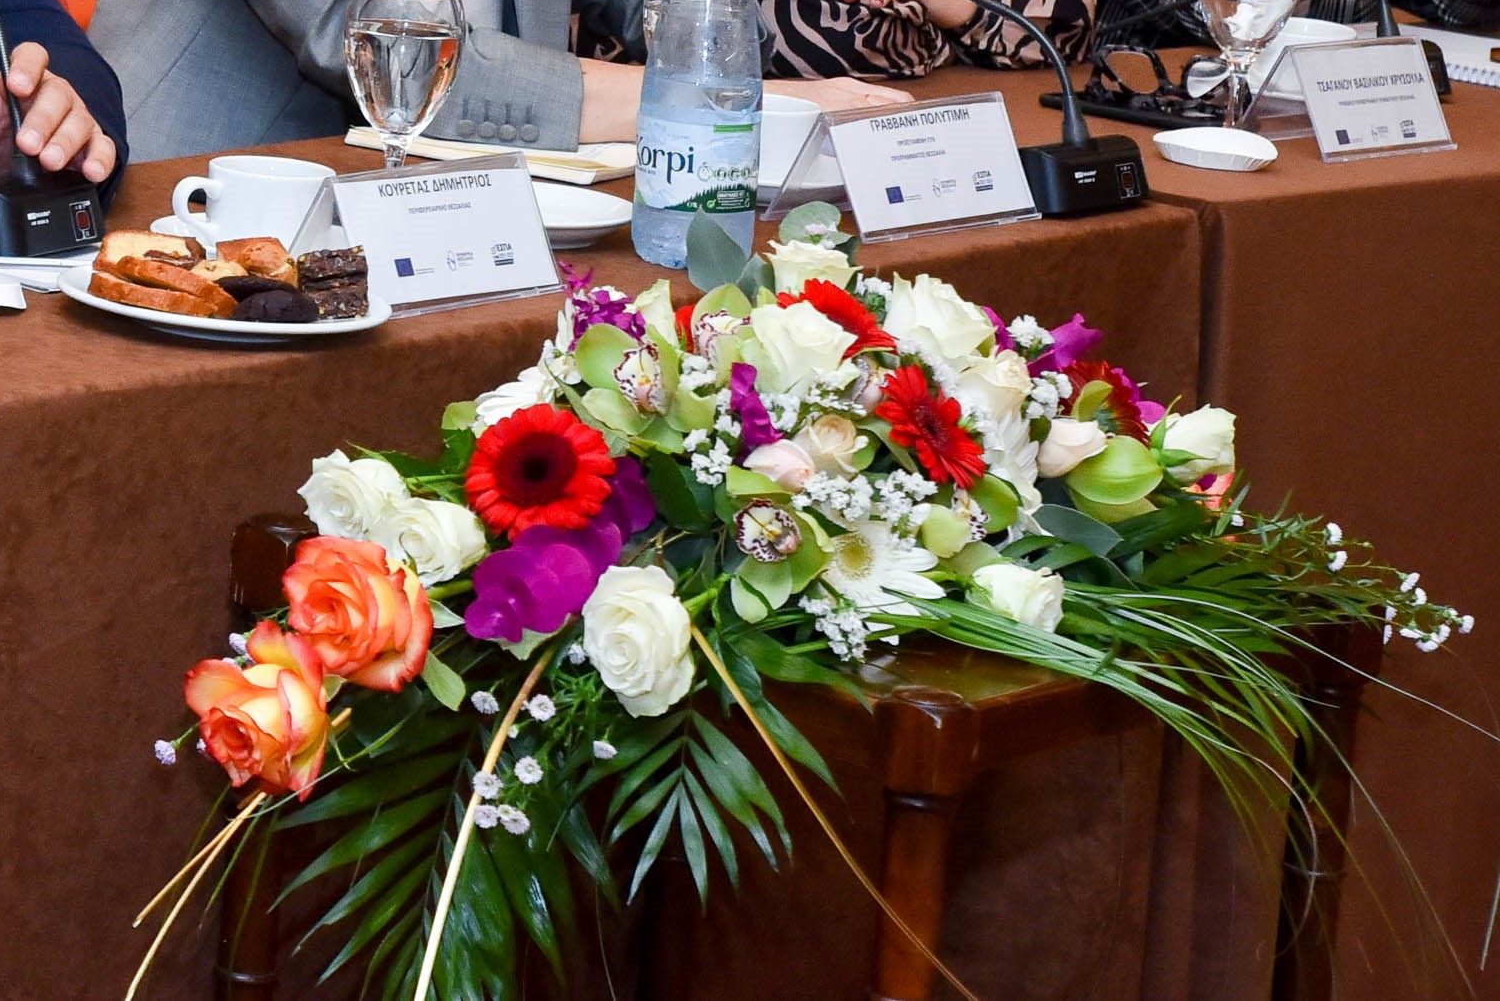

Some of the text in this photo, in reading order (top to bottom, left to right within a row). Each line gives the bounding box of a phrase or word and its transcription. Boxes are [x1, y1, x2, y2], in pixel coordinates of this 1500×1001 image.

[869, 108, 970, 133] ΓΡΑΒΒΑΝΗ ΠΟΛΥΤΙΜΗ
[378, 174, 492, 197] ΚΟΥΡΕΤΑΣ ΔΗΜΗΤΡΙΟΣ
